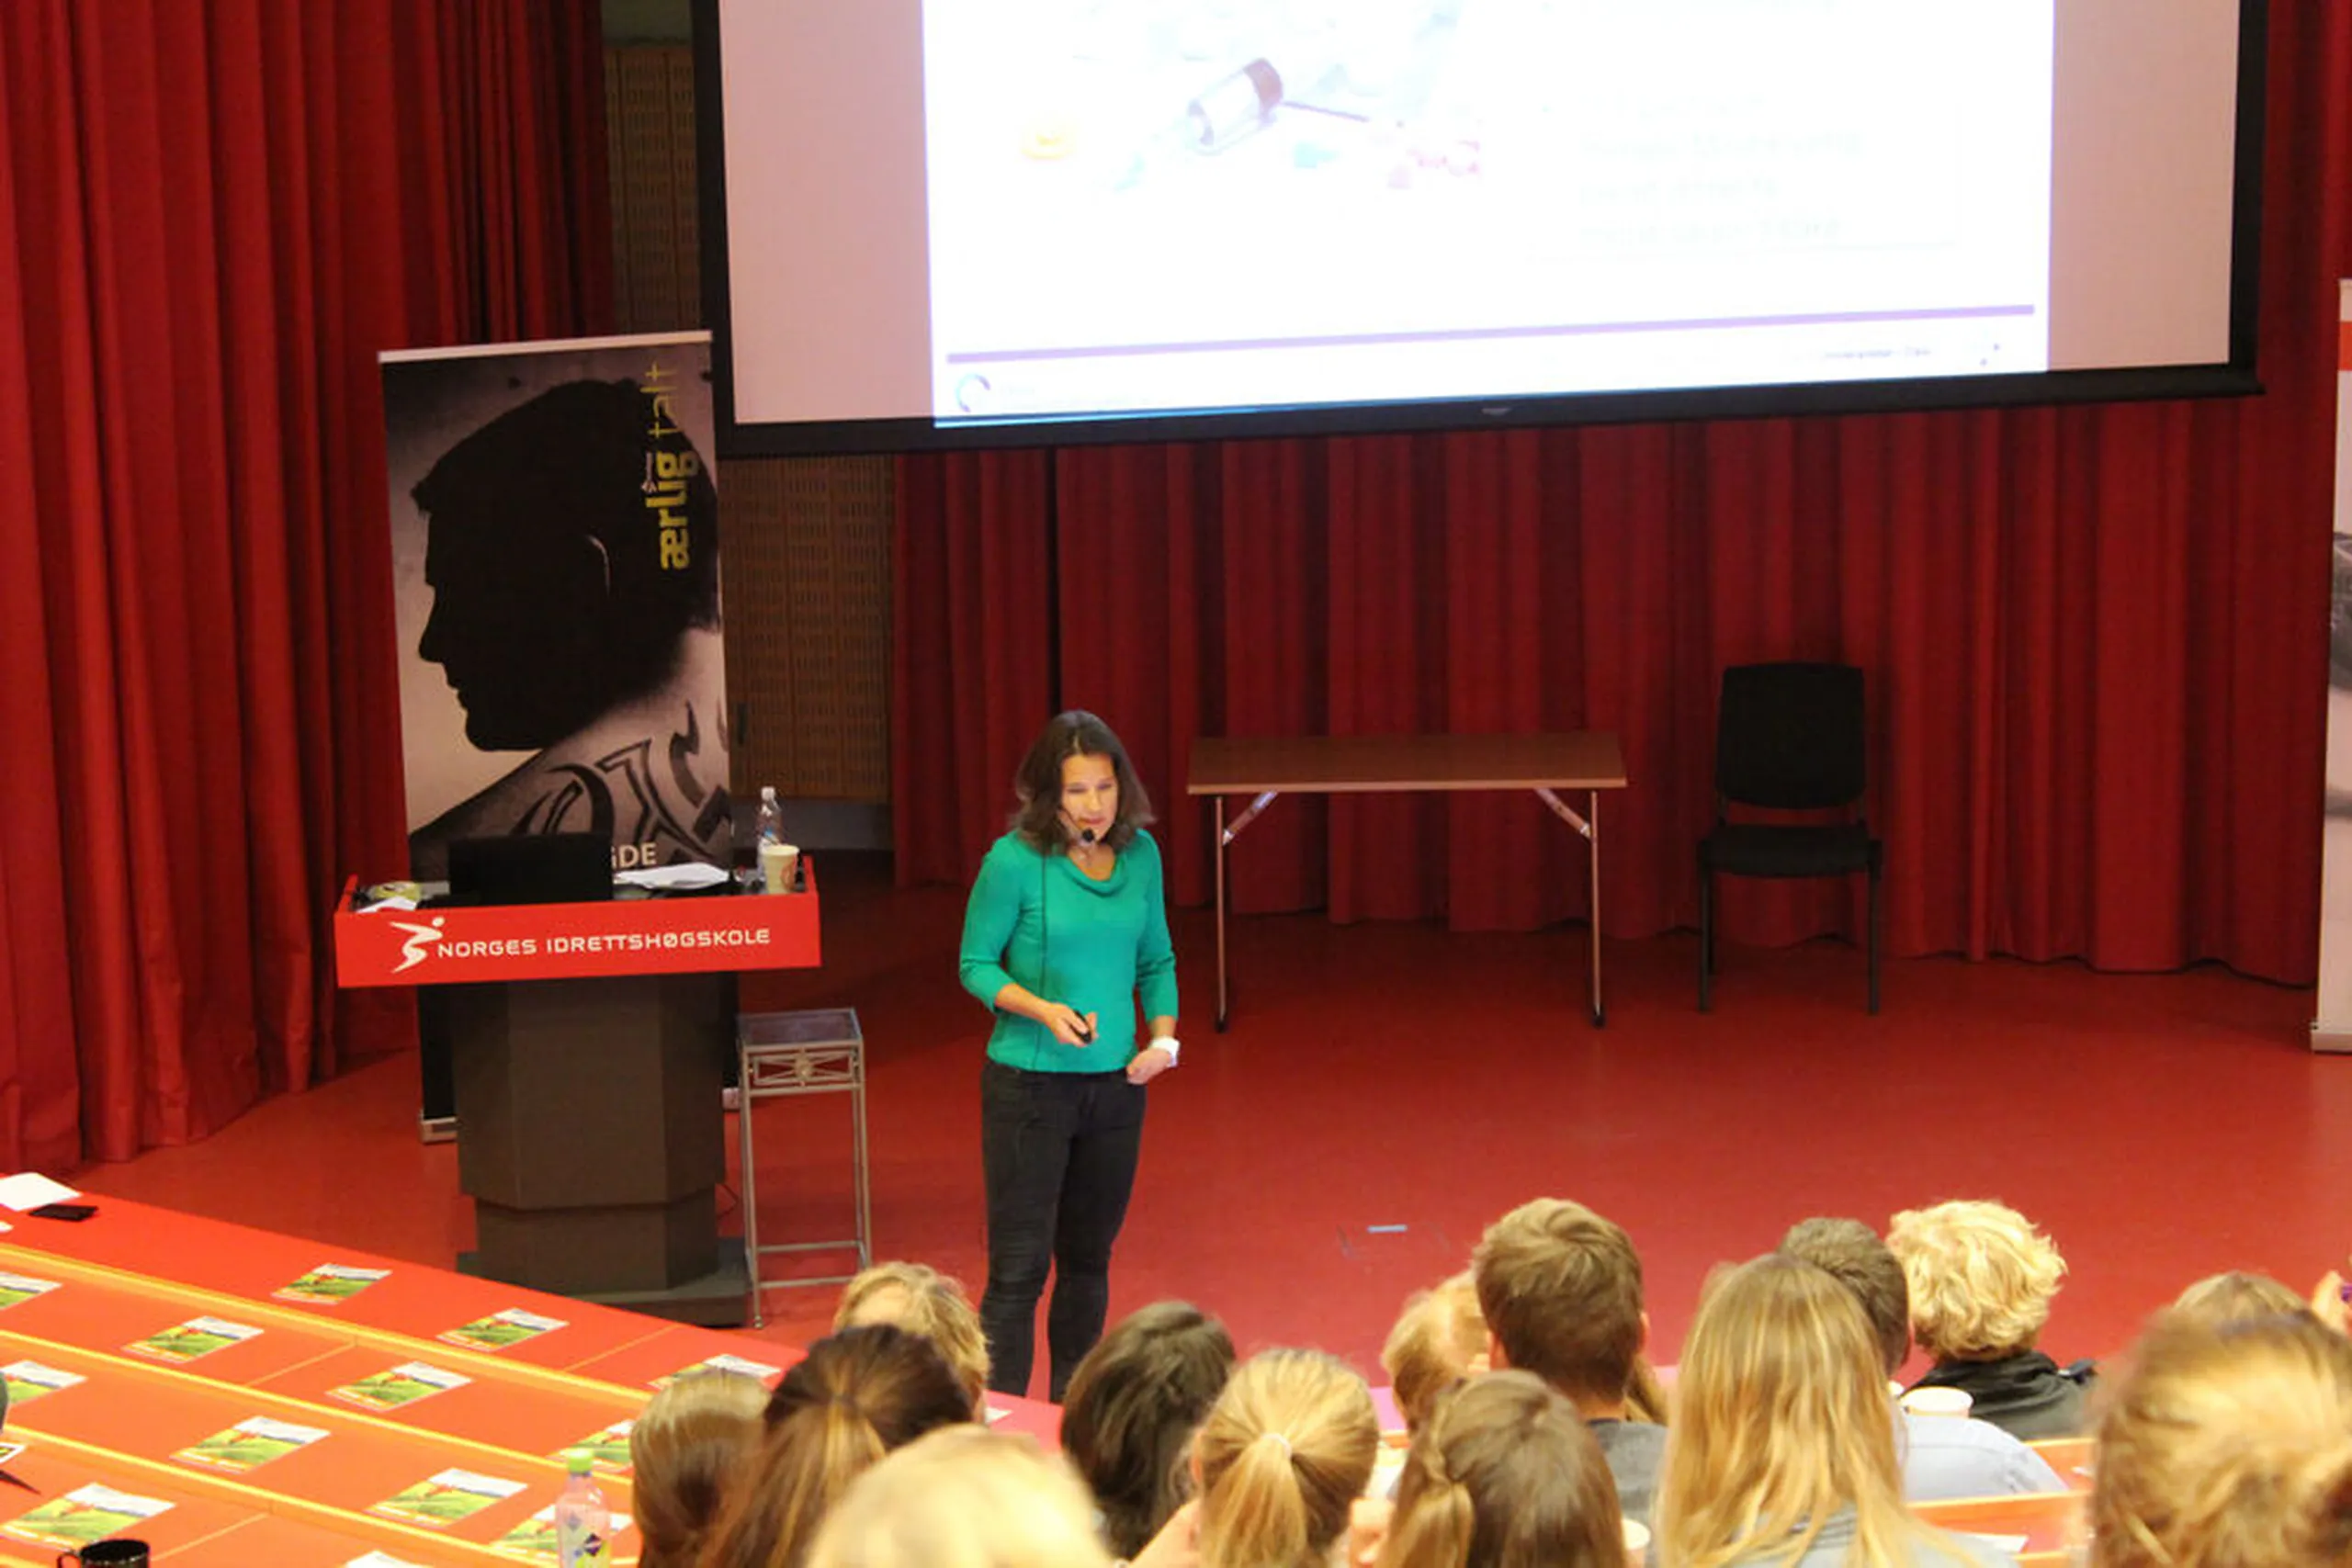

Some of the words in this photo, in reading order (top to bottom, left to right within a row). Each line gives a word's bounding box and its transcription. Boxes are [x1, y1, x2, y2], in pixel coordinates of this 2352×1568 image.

[640, 362, 678, 439] talt
[643, 450, 699, 570] ærlig
[611, 841, 657, 870] DE
[437, 938, 537, 959] NORGES
[546, 928, 771, 953] IDRETTSHØGSKOLE
